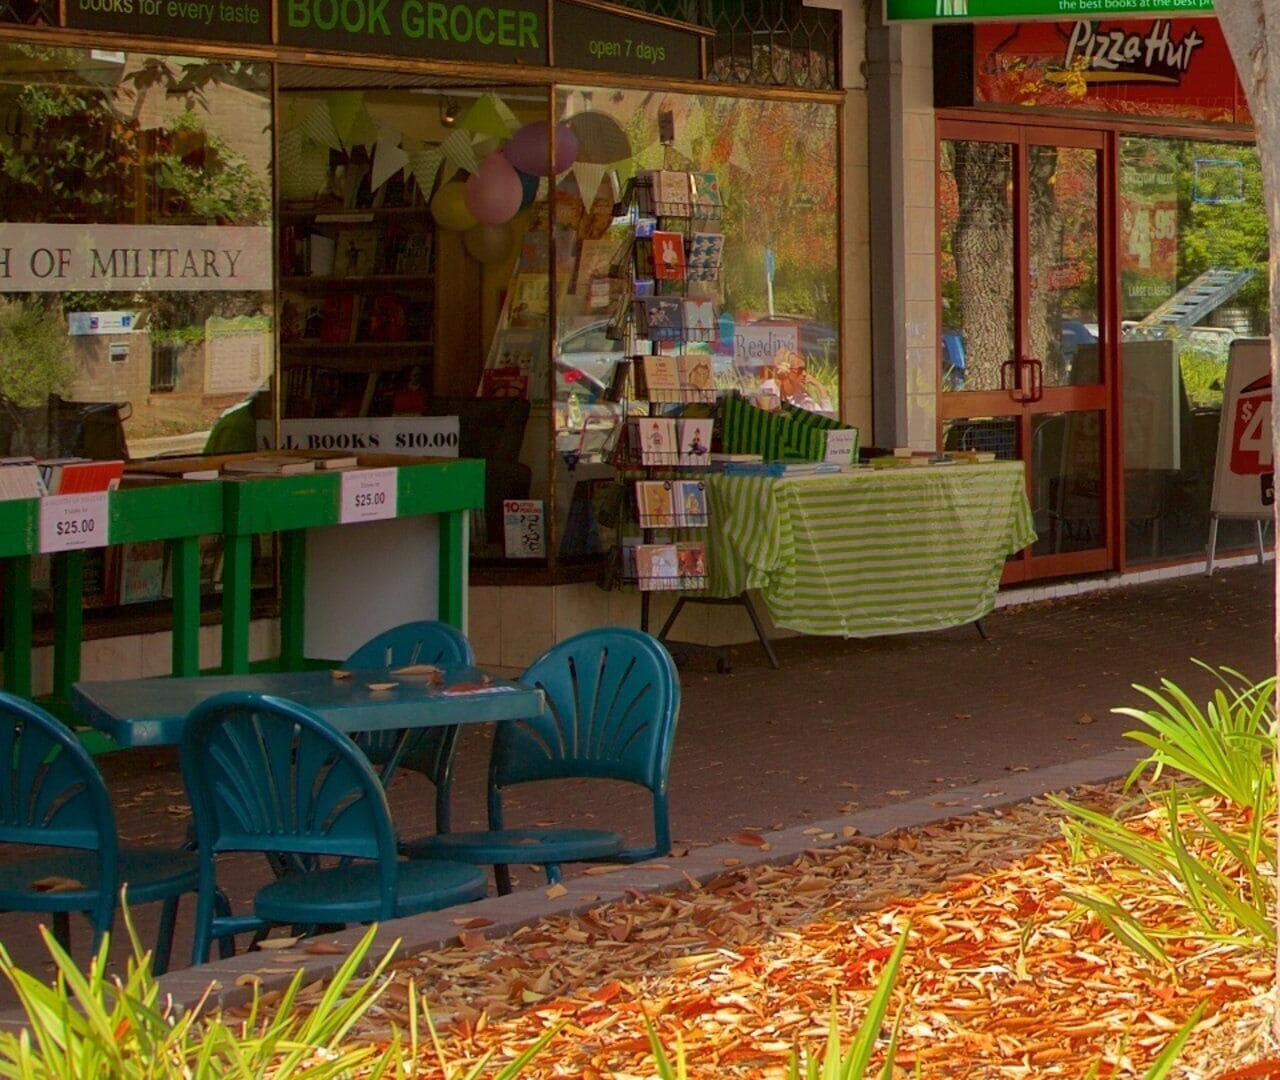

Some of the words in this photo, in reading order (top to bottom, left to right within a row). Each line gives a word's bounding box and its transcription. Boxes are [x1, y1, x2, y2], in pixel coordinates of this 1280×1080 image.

[166, 0, 215, 25] every
[219, 0, 261, 25] taste
[1058, 0, 1077, 10] the
[1139, 0, 1151, 8] at
[400, 0, 540, 48] GROCER
[589, 38, 621, 58] open
[624, 38, 634, 57] 7
[636, 40, 666, 64] days
[1065, 20, 1142, 70] Pizza
[1145, 18, 1203, 70] Hut
[31, 248, 72, 278] OF
[90, 248, 242, 278] MILITARY
[308, 433, 380, 450] BOOKS
[395, 431, 458, 448] $10.00
[355, 492, 386, 508] $25.00
[56, 518, 95, 536] $25.00
